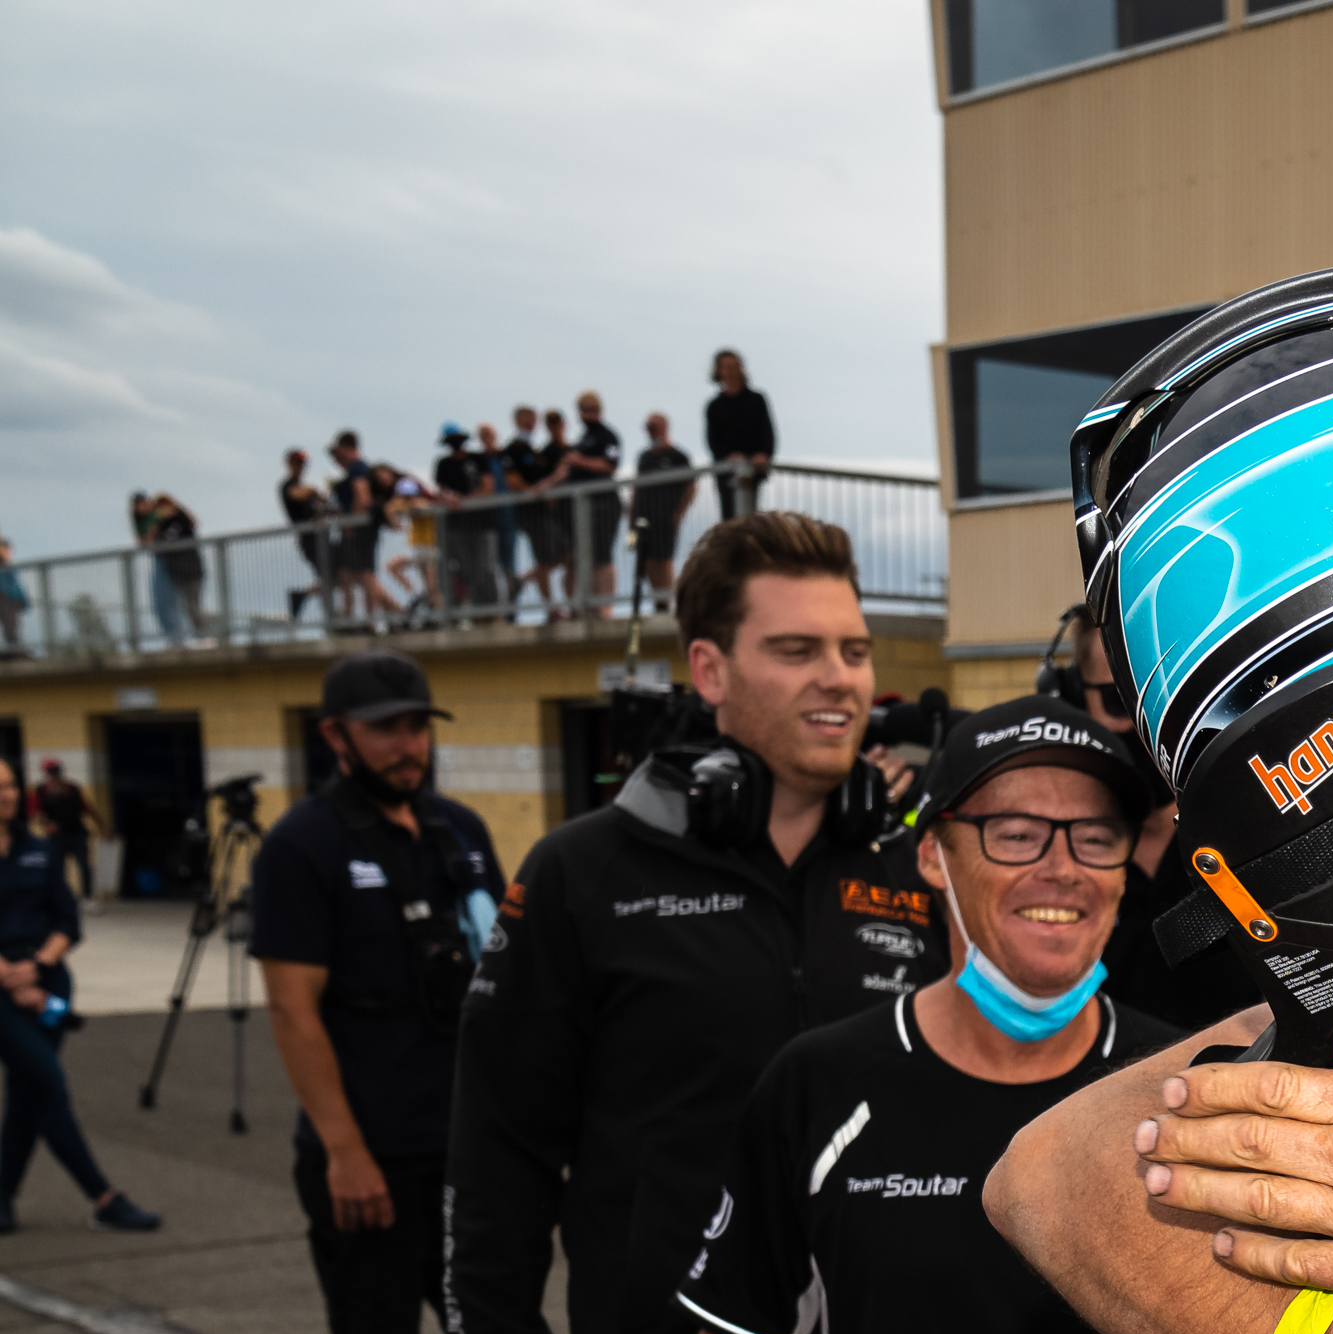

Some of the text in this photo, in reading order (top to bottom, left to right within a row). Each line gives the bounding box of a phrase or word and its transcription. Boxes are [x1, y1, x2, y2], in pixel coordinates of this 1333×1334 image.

[657, 892, 745, 916] Soutar
[847, 1173, 968, 1198] Team Soutar
